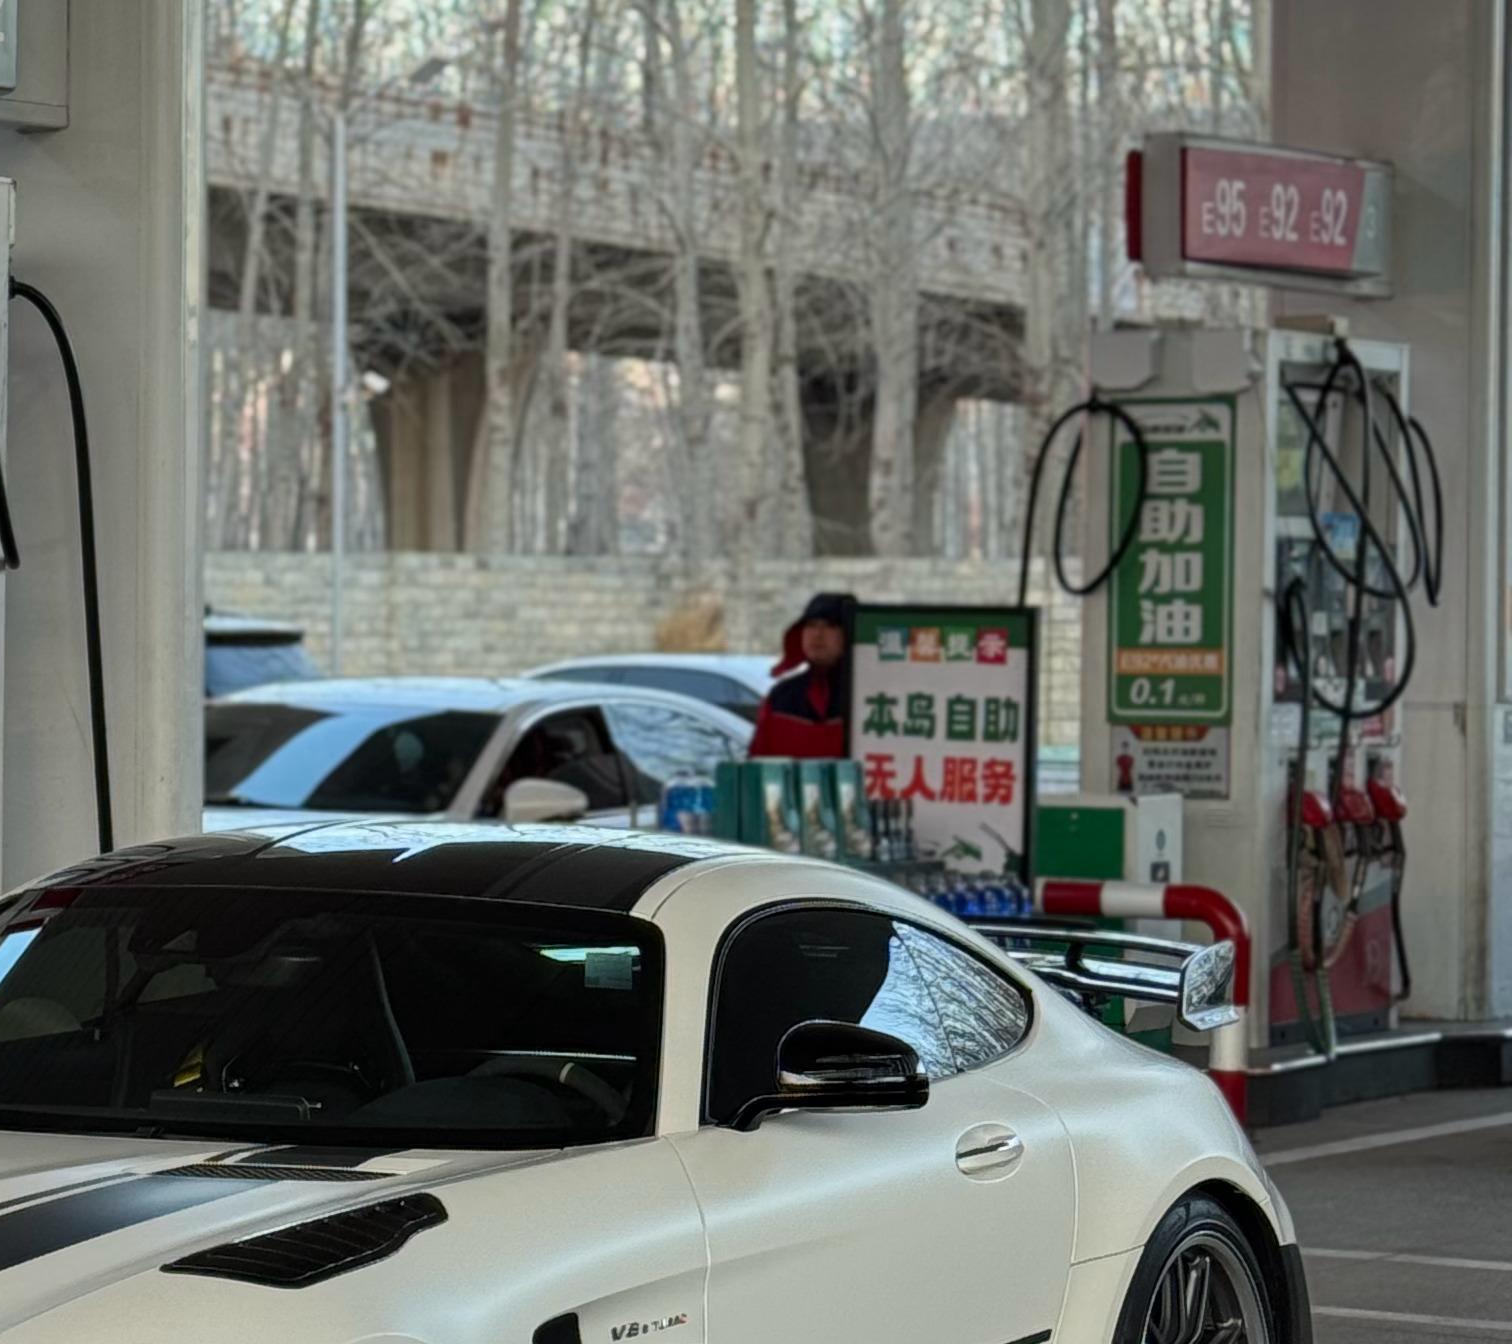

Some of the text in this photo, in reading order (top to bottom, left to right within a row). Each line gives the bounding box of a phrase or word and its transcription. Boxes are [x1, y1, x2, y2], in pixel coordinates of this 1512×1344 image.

[1202, 179, 1247, 238] E95
[1259, 183, 1299, 242] E92
[1310, 189, 1348, 246] E92
[1139, 448, 1205, 645] 自助加油
[1130, 677, 1175, 705] 0.1
[863, 692, 1019, 743] 本岛自助
[865, 753, 1016, 805] 无人服务
[610, 1322, 640, 1341] V8
